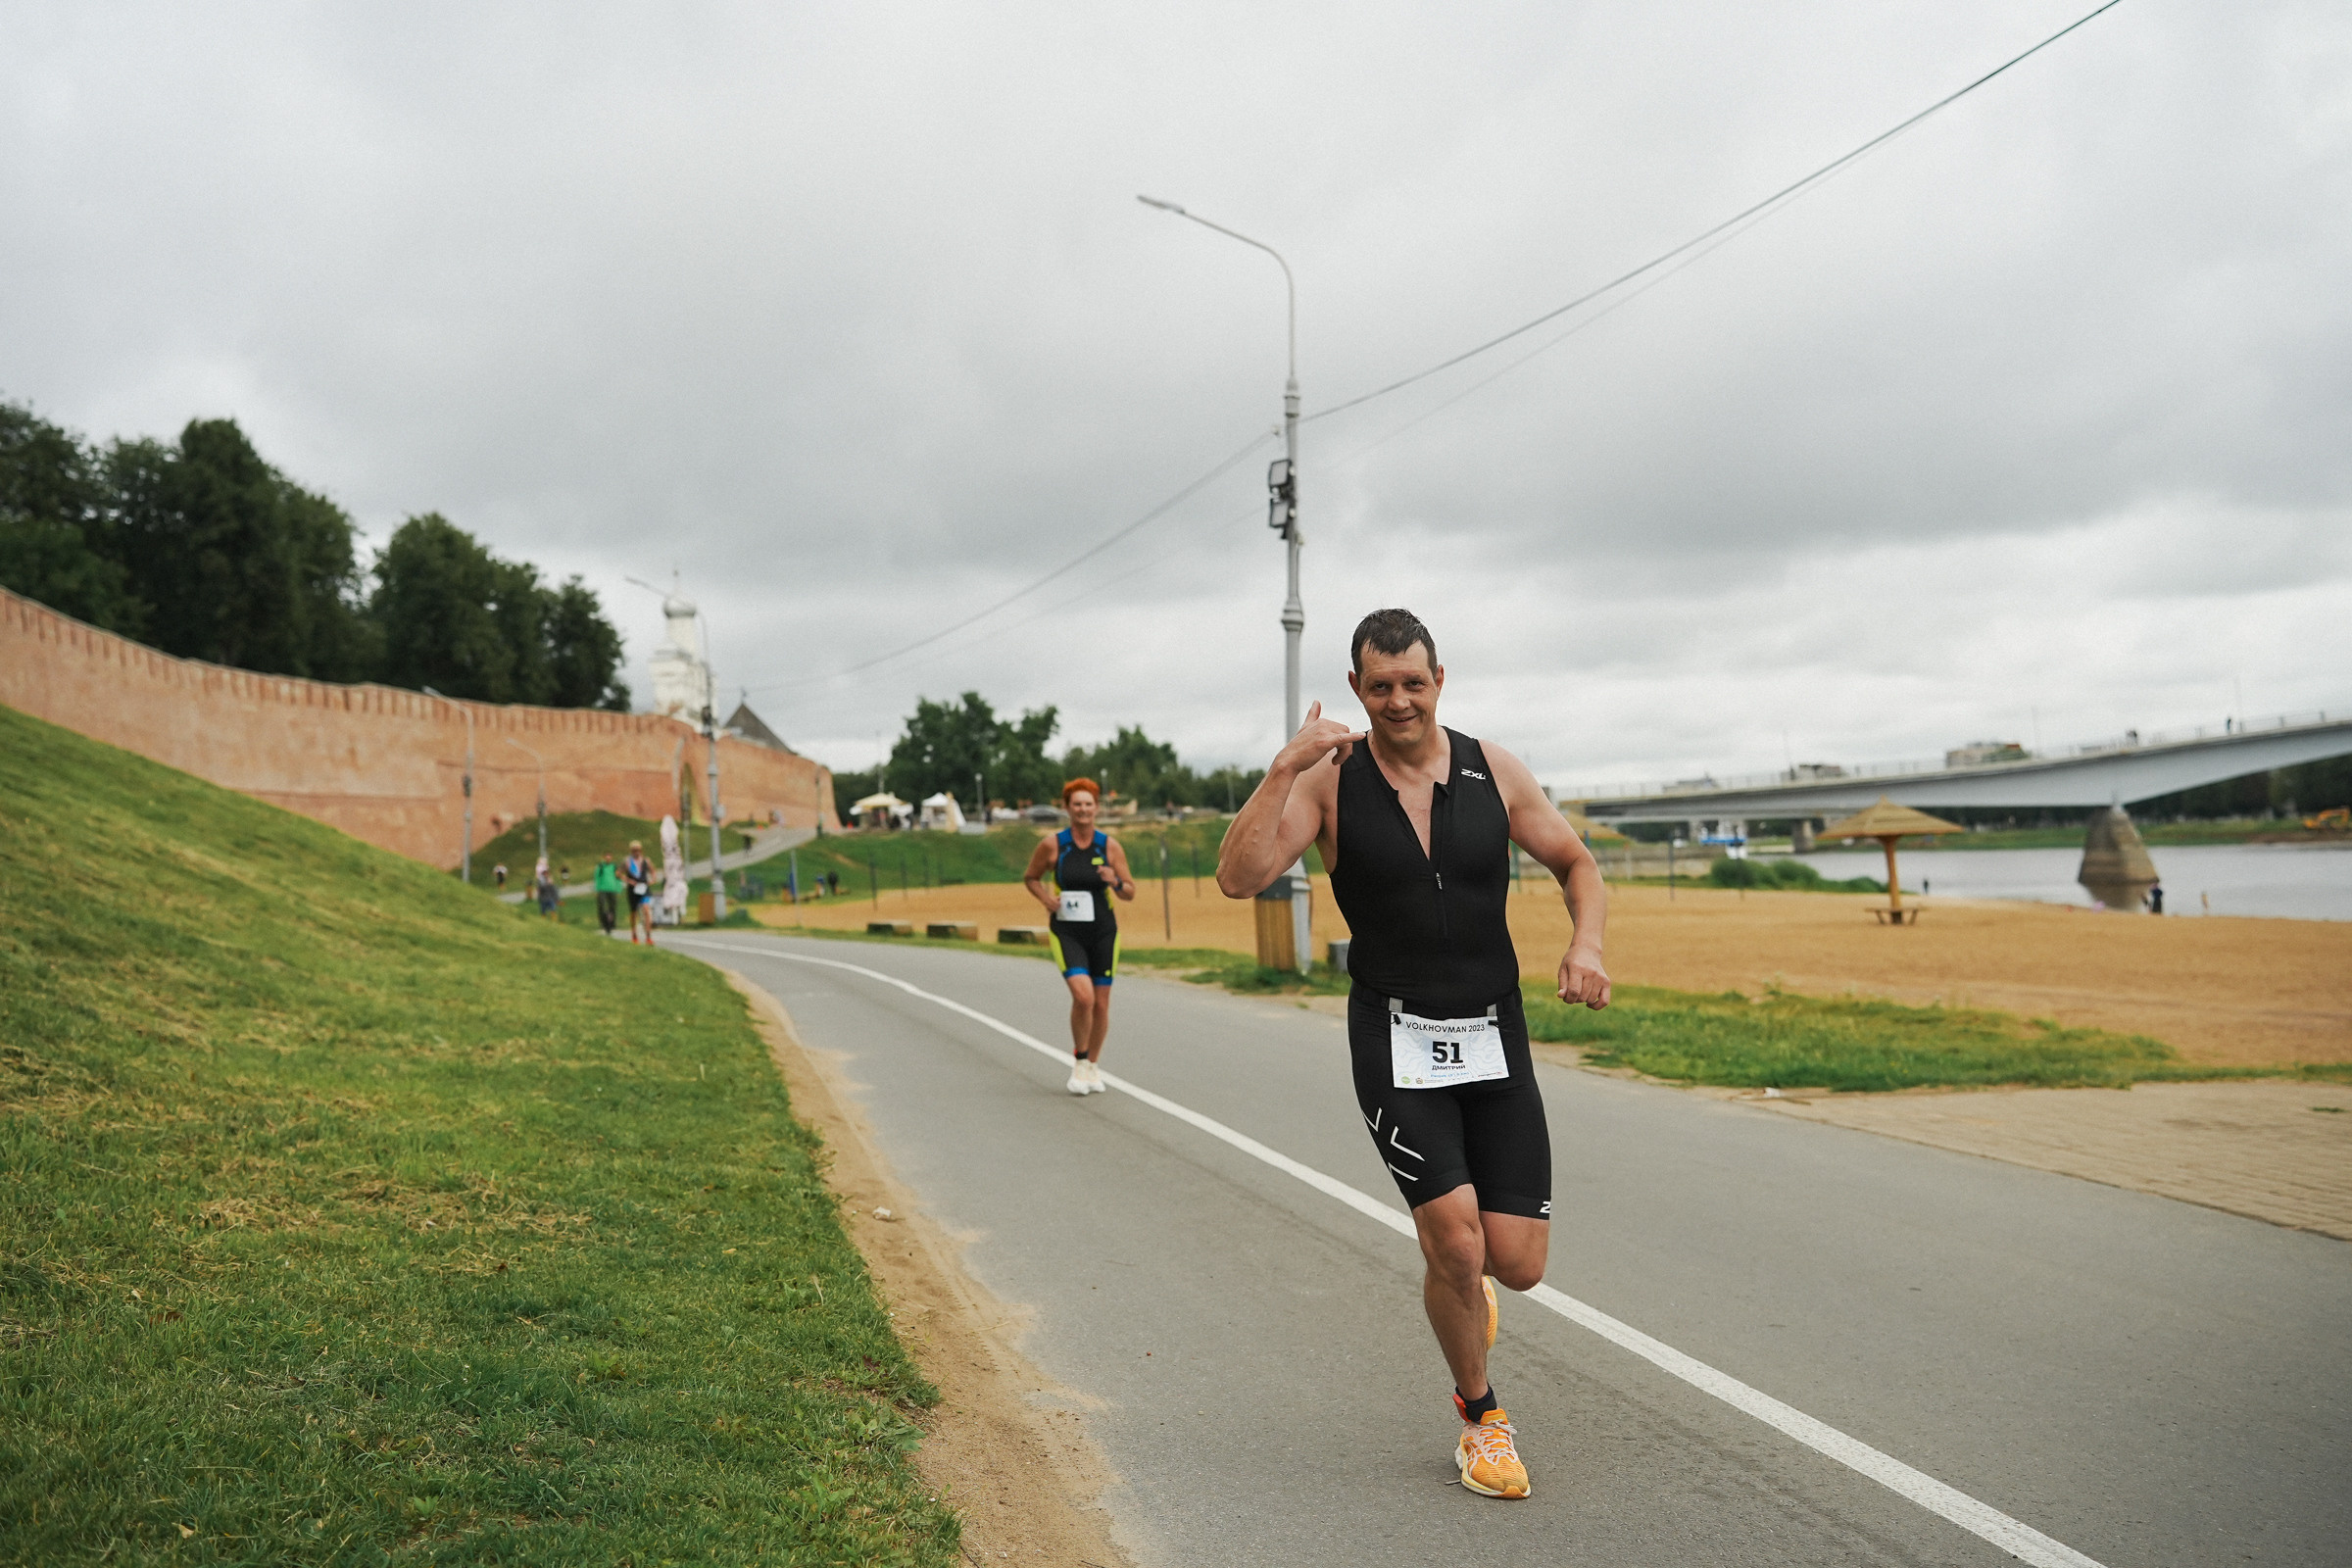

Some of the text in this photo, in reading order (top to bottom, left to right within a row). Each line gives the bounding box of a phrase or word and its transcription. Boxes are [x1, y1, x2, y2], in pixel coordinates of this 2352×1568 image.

[1405, 1021, 1486, 1034] VOLKHOVMAN 2023
[1432, 1041, 1464, 1064] 51
